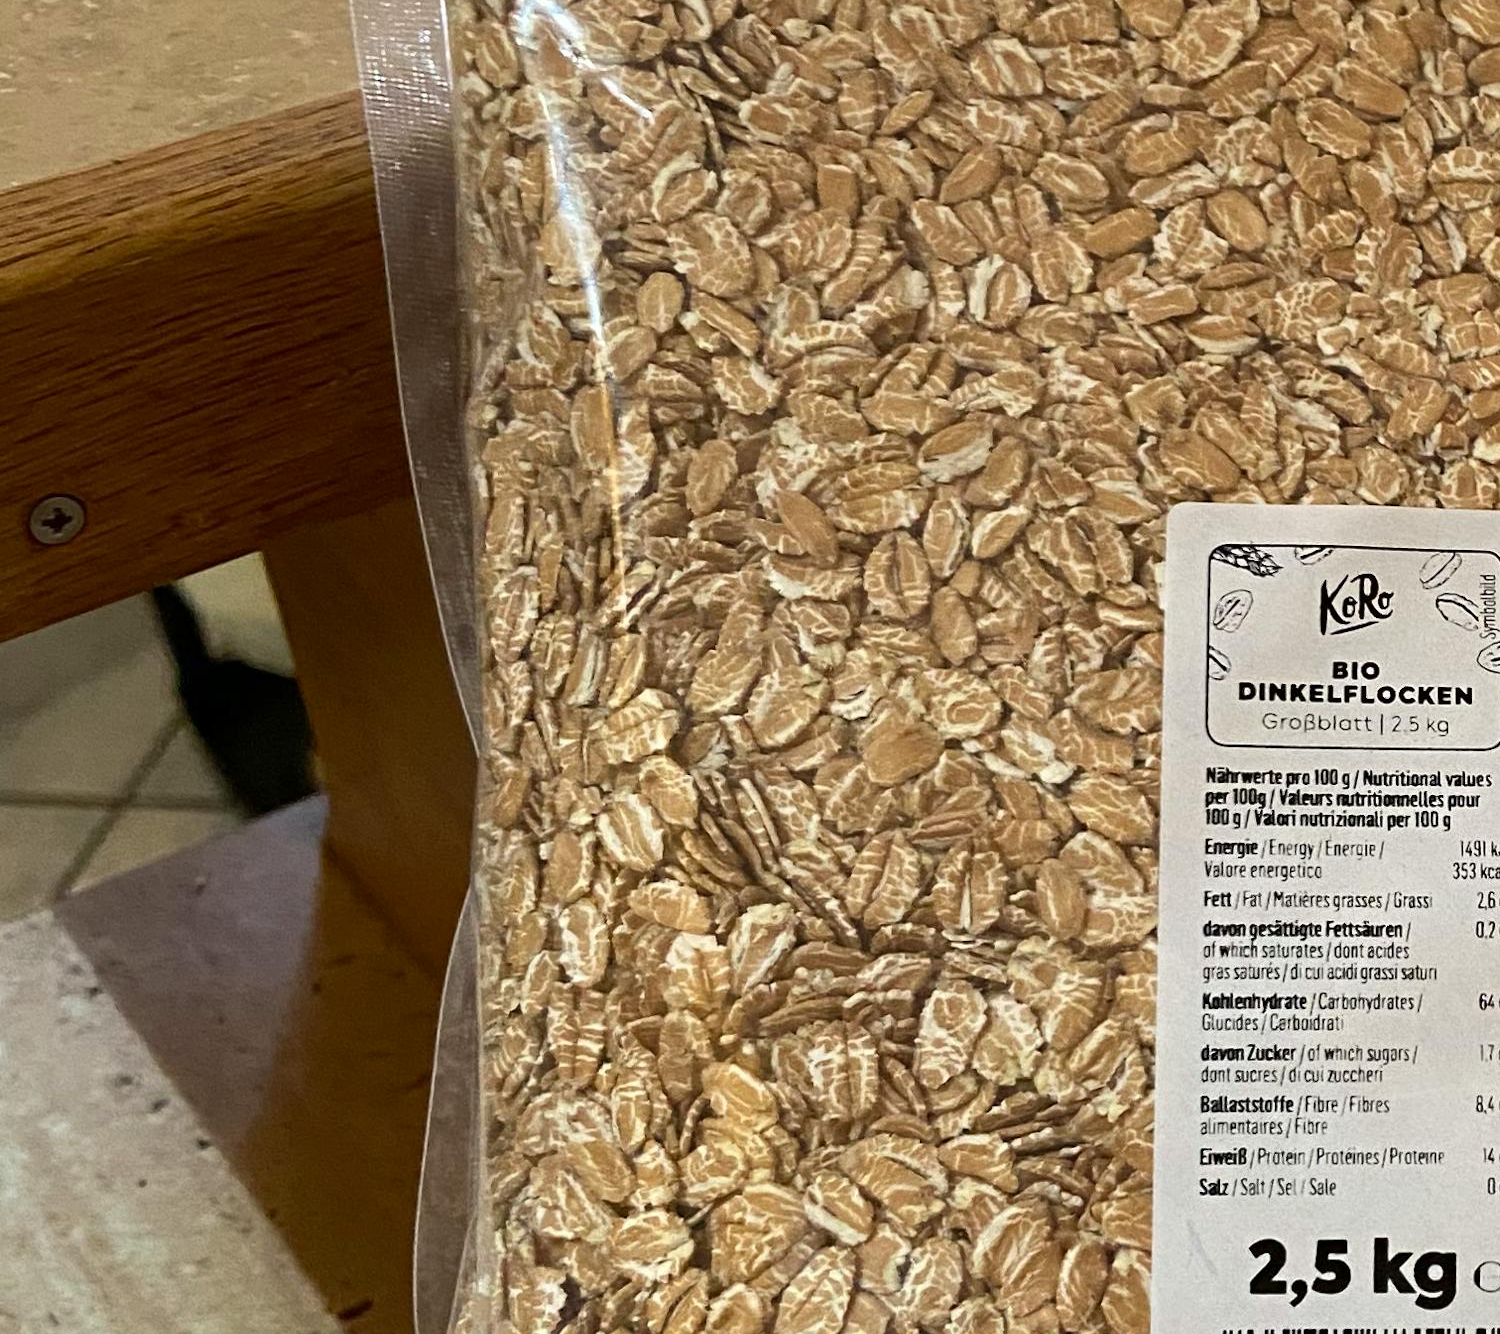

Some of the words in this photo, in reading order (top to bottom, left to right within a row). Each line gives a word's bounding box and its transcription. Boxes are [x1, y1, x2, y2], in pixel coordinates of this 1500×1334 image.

[1320, 574, 1394, 635] KoRo
[1479, 575, 1500, 639] Symbolbild
[1332, 662, 1380, 680] BIO
[1239, 682, 1472, 705] DINKELFLOCKEN
[1262, 713, 1372, 733] Großblatt
[1427, 719, 1448, 737] kg
[1206, 767, 1282, 784] Nährwerte
[1286, 773, 1310, 788] pro
[1315, 769, 1338, 785] 100
[1342, 773, 1350, 789] g
[1363, 770, 1442, 787] Nutritional
[1445, 771, 1492, 787] values
[1205, 792, 1229, 808] per
[1233, 788, 1266, 810] 100g
[1280, 789, 1333, 806] Valeurs
[1336, 790, 1444, 808] nutritionnelles
[1448, 795, 1480, 811] pour
[1206, 808, 1229, 825] 100
[1233, 813, 1241, 829] g
[1254, 808, 1296, 826] Valori
[1300, 810, 1383, 827] nutrizionali
[1387, 815, 1411, 831] per
[1415, 811, 1438, 828] 100
[1443, 815, 1450, 831] g
[1205, 838, 1258, 858] Energie
[1269, 839, 1314, 859] Energy
[1461, 841, 1486, 857] 1491
[1204, 861, 1246, 878] Valore
[1453, 862, 1476, 879] 353
[1204, 891, 1231, 907] Fett
[1243, 891, 1262, 907] Fat
[1333, 895, 1382, 912] grasses
[1203, 920, 1246, 937] davon
[1262, 944, 1323, 958] saturates
[1334, 942, 1364, 958] dont
[1368, 942, 1409, 959] acides
[1203, 966, 1230, 983] gras
[1202, 993, 1307, 1014] Kohlenhydrate
[1319, 992, 1414, 1013] Carbohydrates
[1479, 993, 1494, 1010] 64
[1201, 1044, 1244, 1061] davon
[1247, 1044, 1296, 1061] Zucker
[1367, 1049, 1409, 1065] sugars
[1235, 1070, 1277, 1082] sucres
[1201, 1095, 1293, 1113] Ballaststoffe
[1305, 1095, 1338, 1113] Fibre
[1349, 1096, 1390, 1113] Fibres
[1484, 1148, 1494, 1163] 14
[1200, 1178, 1228, 1196] Salz
[1310, 1178, 1336, 1196] Sale
[1488, 1177, 1496, 1195] 0
[1249, 1239, 1351, 1307] 2,5
[1373, 1238, 1457, 1310] kg
